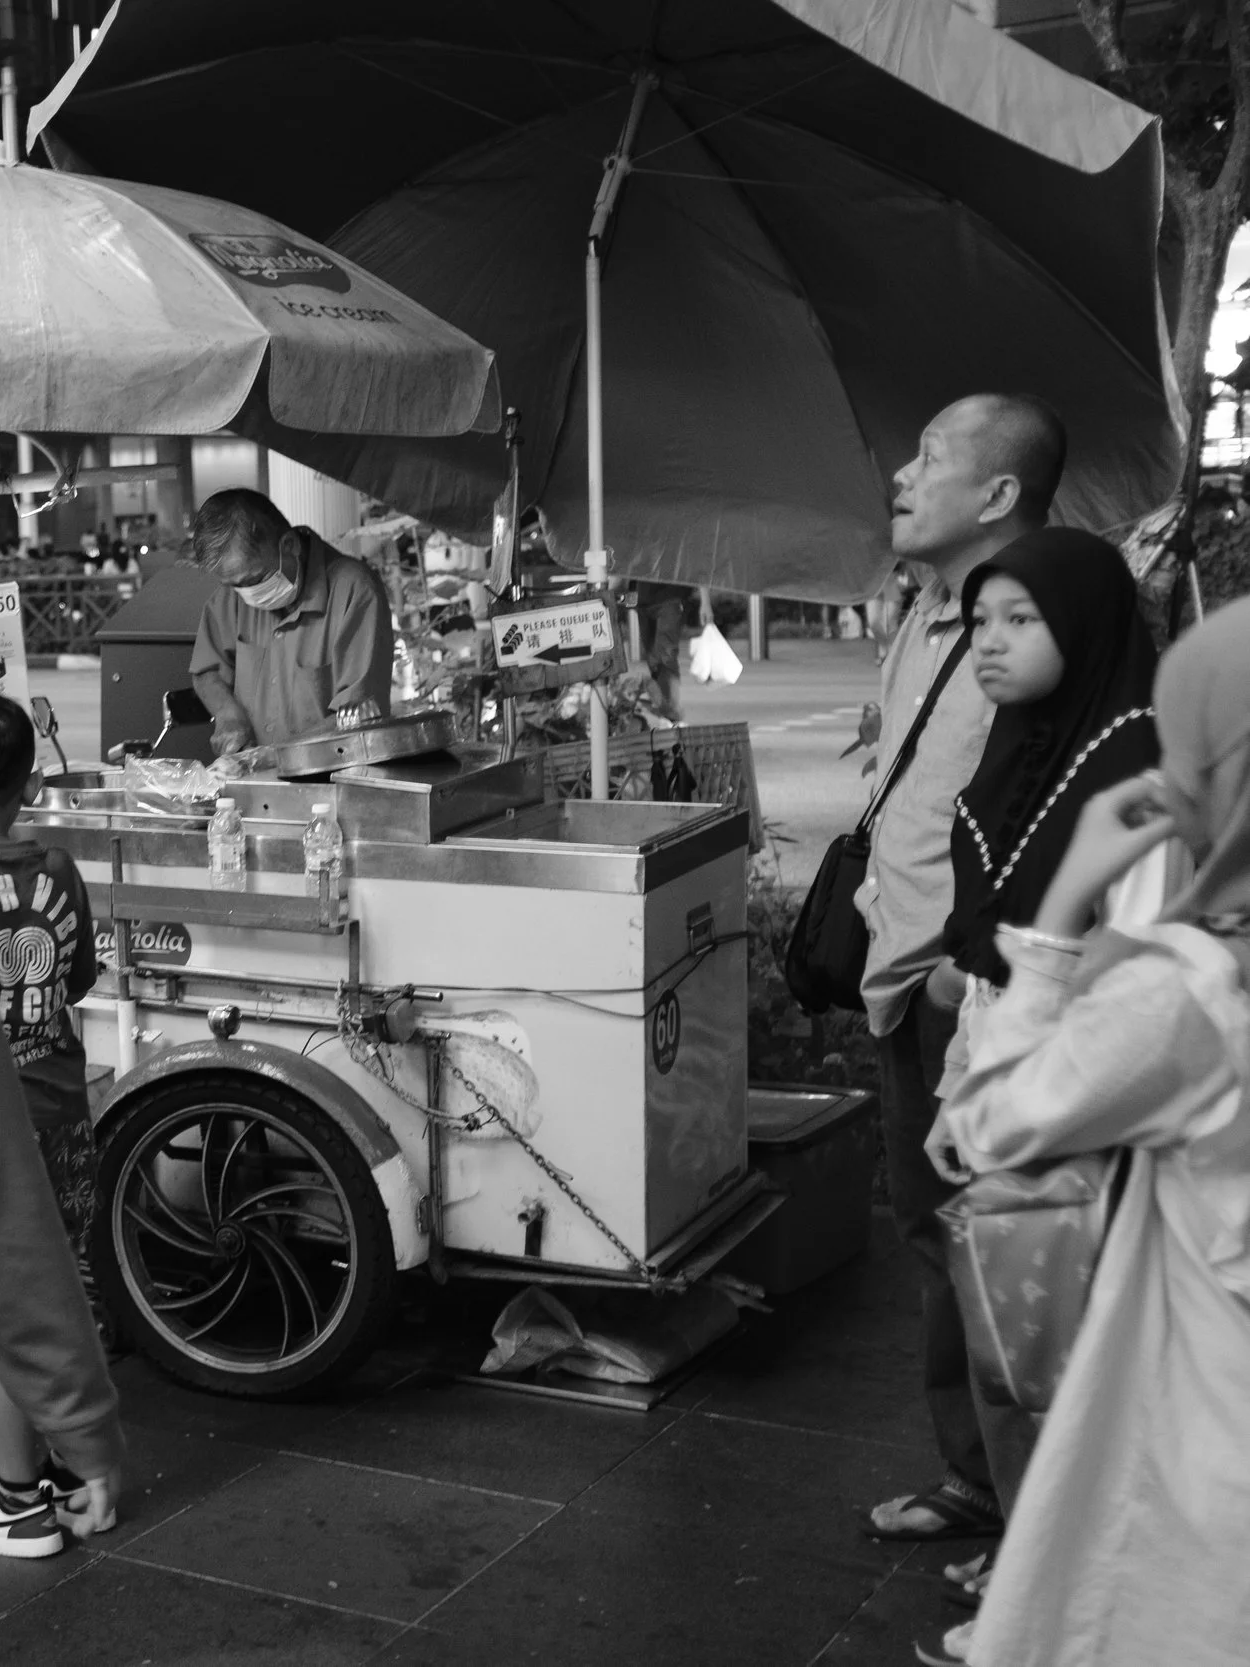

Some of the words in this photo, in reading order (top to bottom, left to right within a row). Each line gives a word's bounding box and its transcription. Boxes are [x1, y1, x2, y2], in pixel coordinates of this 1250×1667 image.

[199, 241, 333, 280] Magnolia
[523, 619, 558, 632] PLEASE
[560, 613, 589, 625] QUEUE
[592, 610, 605, 621] UP
[92, 920, 187, 959] anolia
[656, 999, 677, 1050] 60
